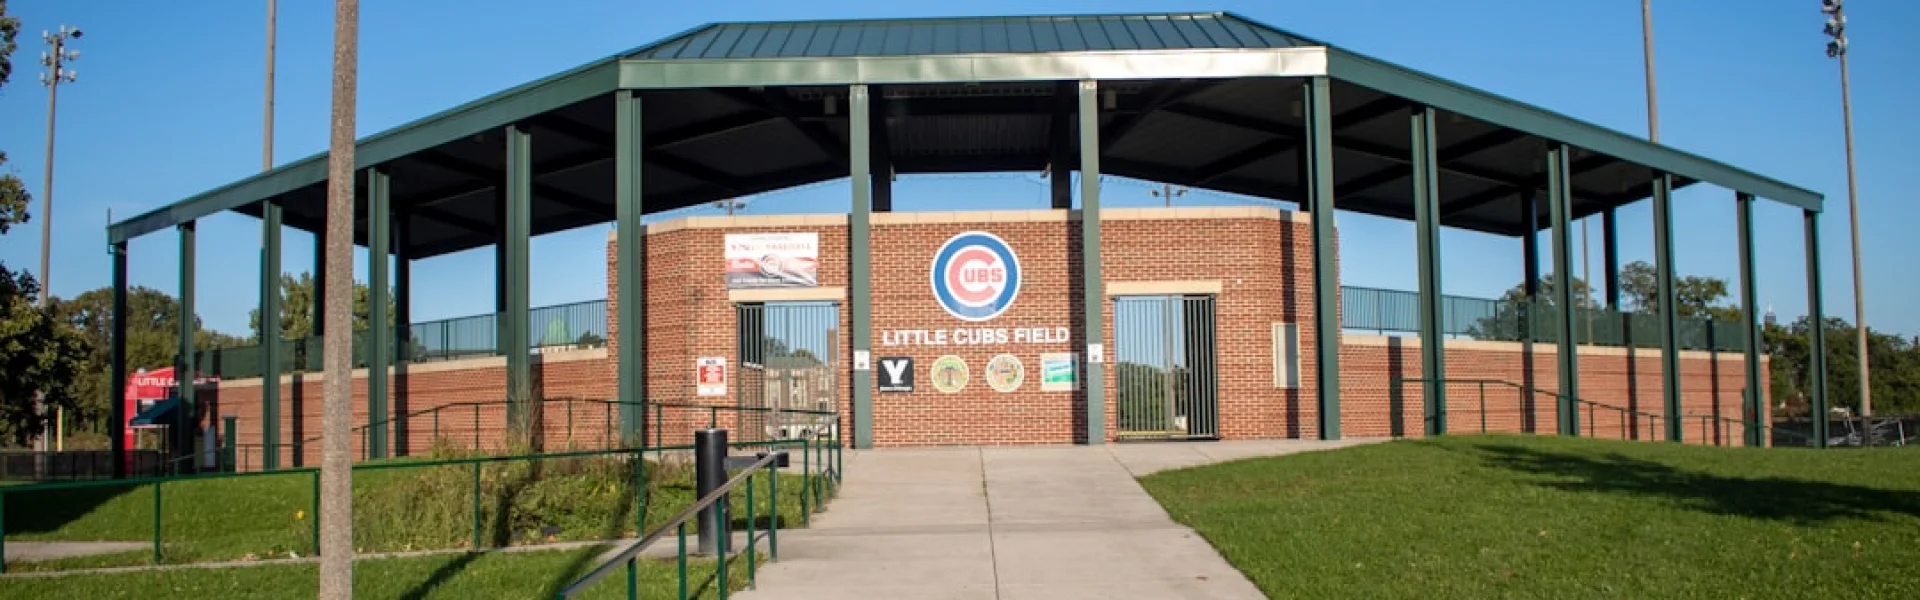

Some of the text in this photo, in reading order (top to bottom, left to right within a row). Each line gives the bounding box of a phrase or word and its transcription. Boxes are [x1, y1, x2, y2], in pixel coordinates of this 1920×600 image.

[948, 249, 1004, 302] CUBS
[883, 327, 1070, 346] LITTLE CUBS FIELD
